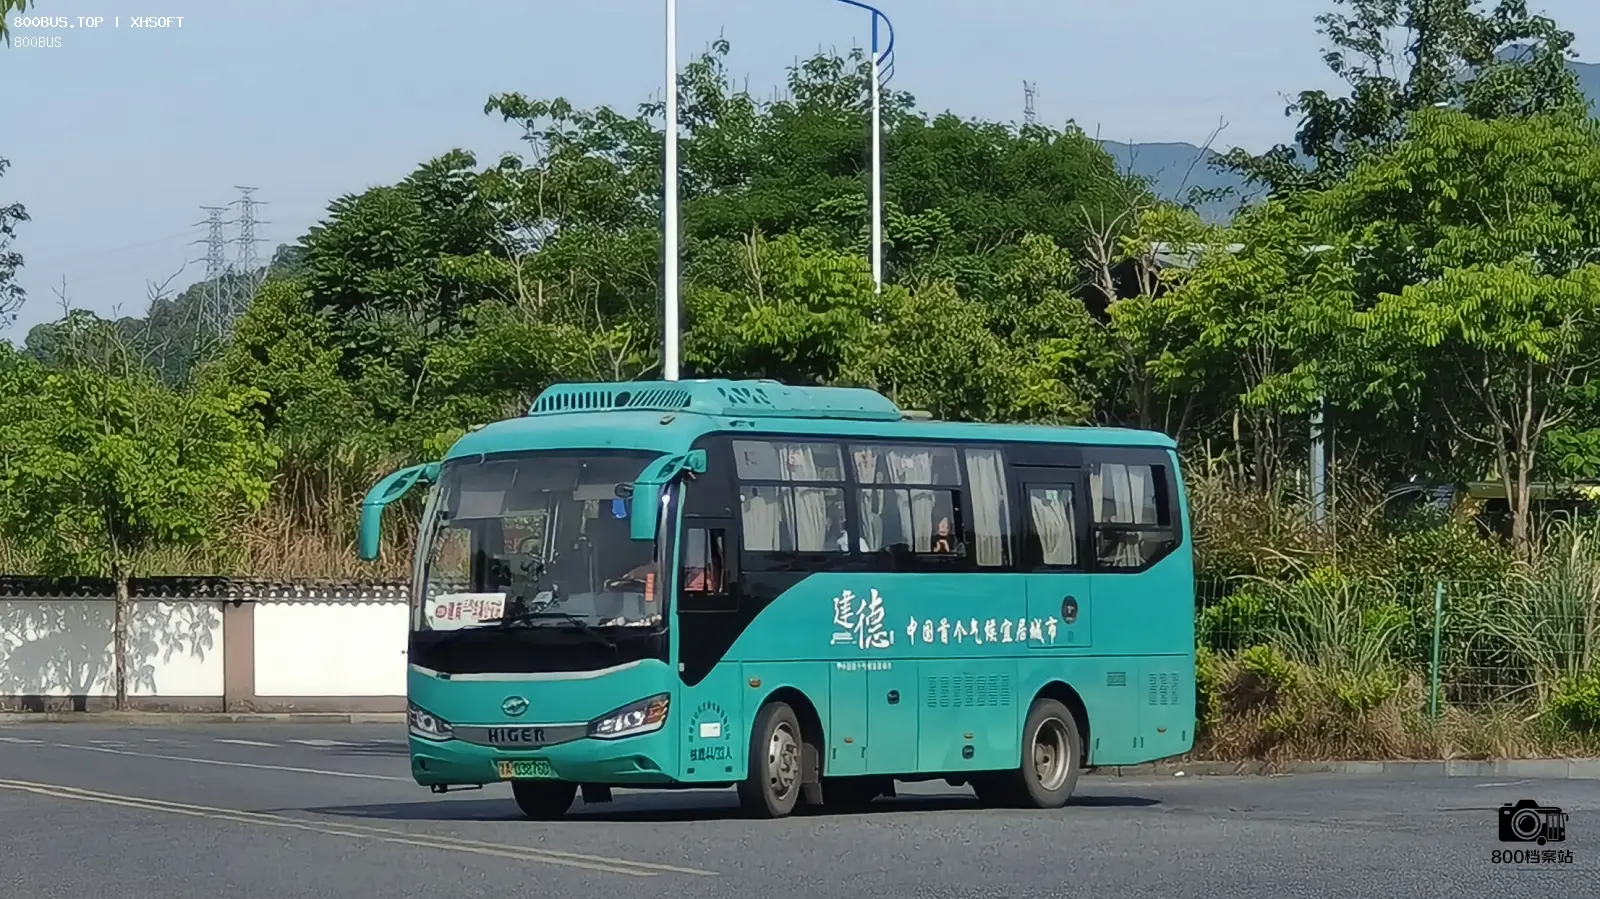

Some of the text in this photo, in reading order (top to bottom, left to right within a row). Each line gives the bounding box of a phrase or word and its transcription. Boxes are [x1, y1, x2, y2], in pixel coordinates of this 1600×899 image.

[832, 588, 891, 649] 建德
[906, 616, 1059, 646] 中国首个气候宜居城市
[488, 727, 546, 742] HIGER
